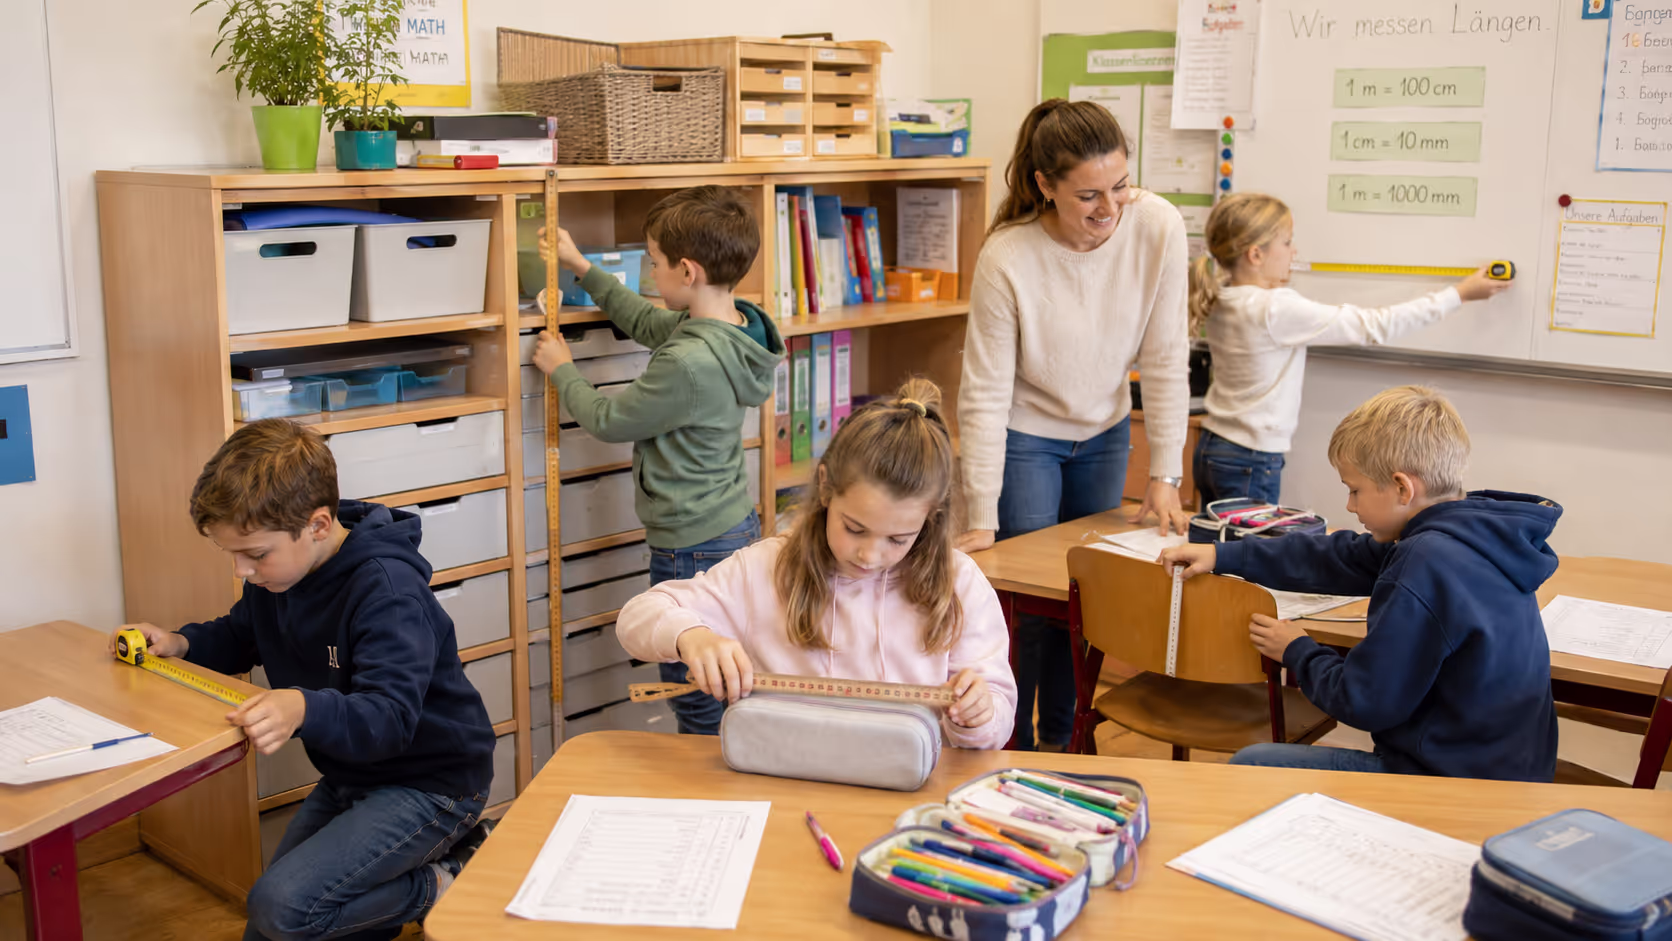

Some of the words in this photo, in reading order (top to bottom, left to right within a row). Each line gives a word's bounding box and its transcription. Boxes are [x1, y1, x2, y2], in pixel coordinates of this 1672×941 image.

[407, 17, 446, 35] MATH
[1289, 8, 1337, 39] Wir
[1355, 16, 1434, 37] messen
[1345, 78, 1354, 97] 1
[1362, 84, 1377, 96] m
[1400, 77, 1431, 96] 100
[1433, 83, 1458, 96] cm
[1340, 130, 1349, 149] 1
[1352, 137, 1376, 149] cm
[1397, 130, 1417, 150] 10
[1420, 137, 1450, 150] mm
[1338, 183, 1346, 201] 1
[1353, 189, 1367, 201] m
[1388, 184, 1428, 203] 1000
[1431, 191, 1460, 205] mm
[1565, 206, 1602, 221] Unsere
[1607, 207, 1659, 227] Aufgaben
